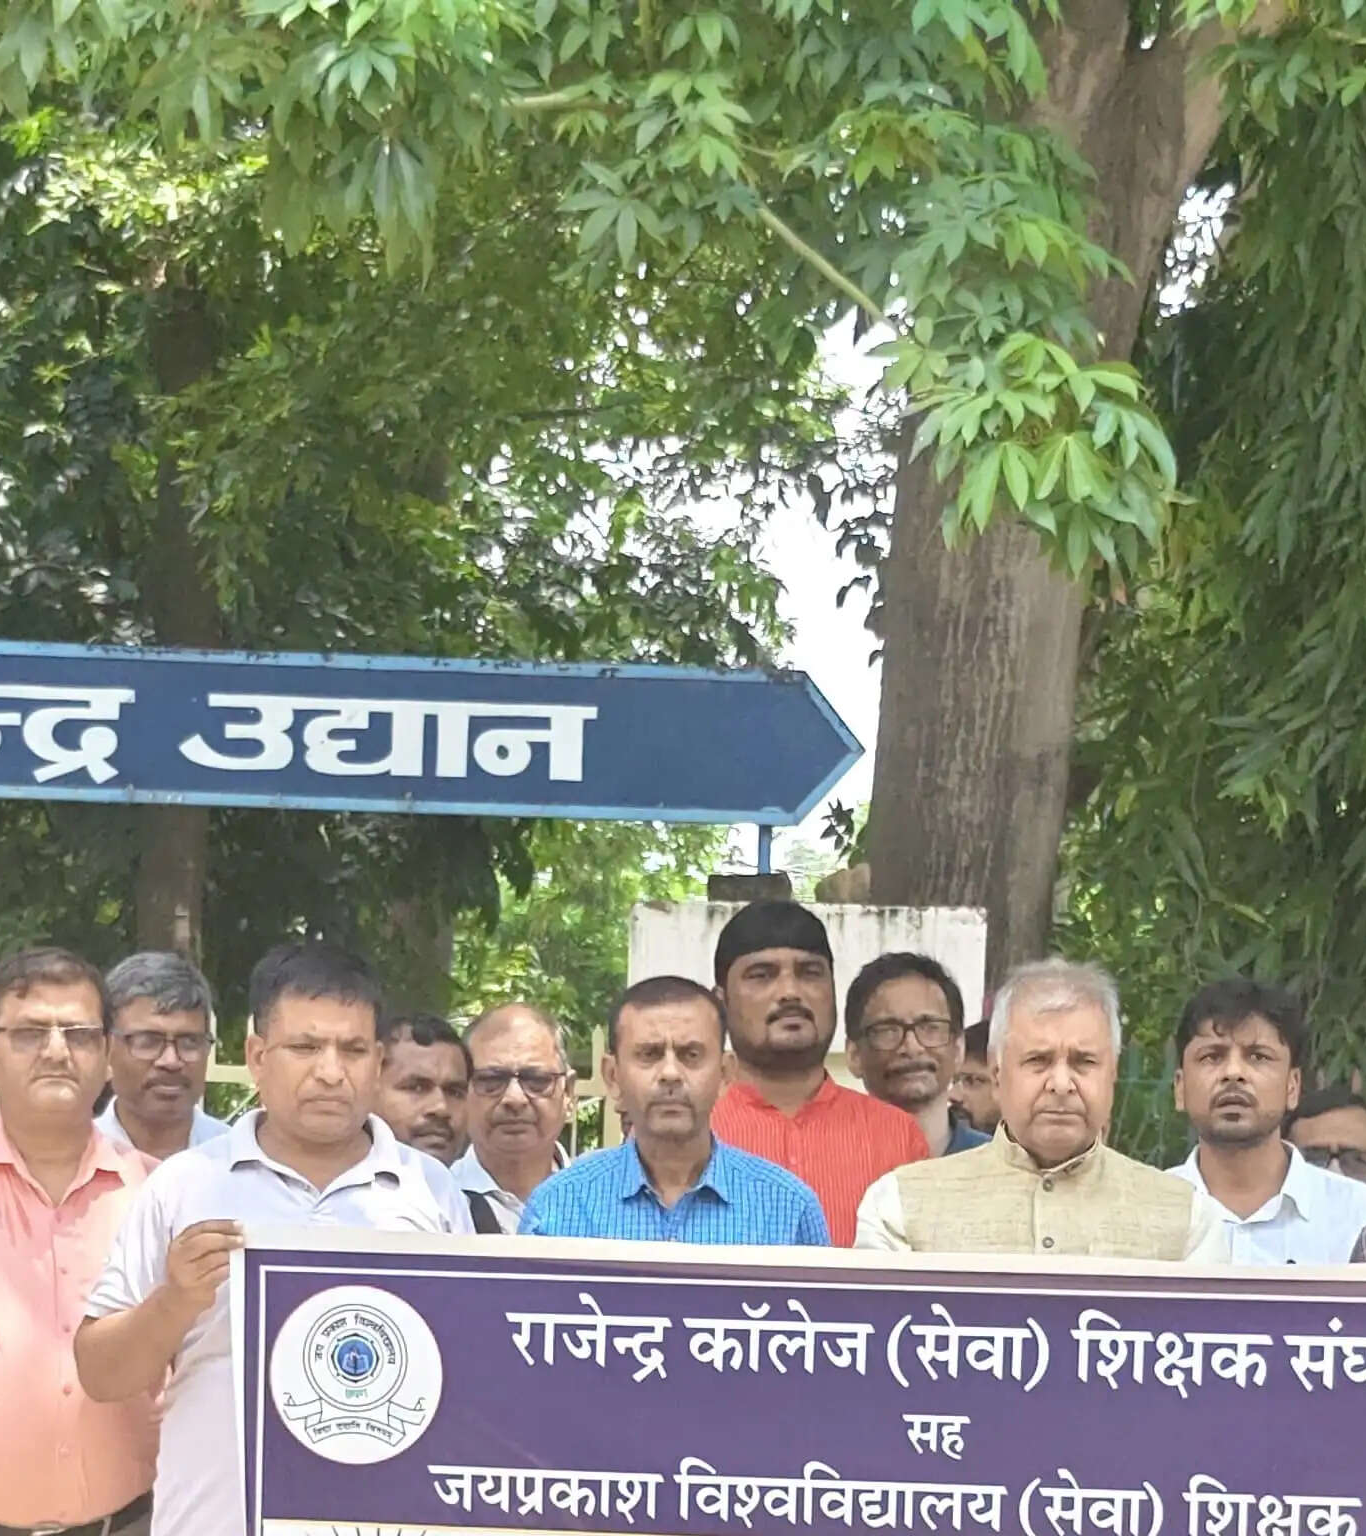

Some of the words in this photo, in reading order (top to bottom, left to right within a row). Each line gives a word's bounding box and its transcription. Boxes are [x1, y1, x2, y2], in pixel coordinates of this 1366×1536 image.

[178, 691, 598, 782] उद्यान
[506, 1293, 672, 1382] राजेन्द्र
[683, 1299, 875, 1375] कॉलेज
[887, 1304, 1049, 1391] (सेवा)
[1071, 1309, 1273, 1398] शिक्षक
[903, 1415, 970, 1459] सह
[427, 1464, 664, 1520] जयप्रकाश
[673, 1456, 1008, 1531] विश्वविद्यालय
